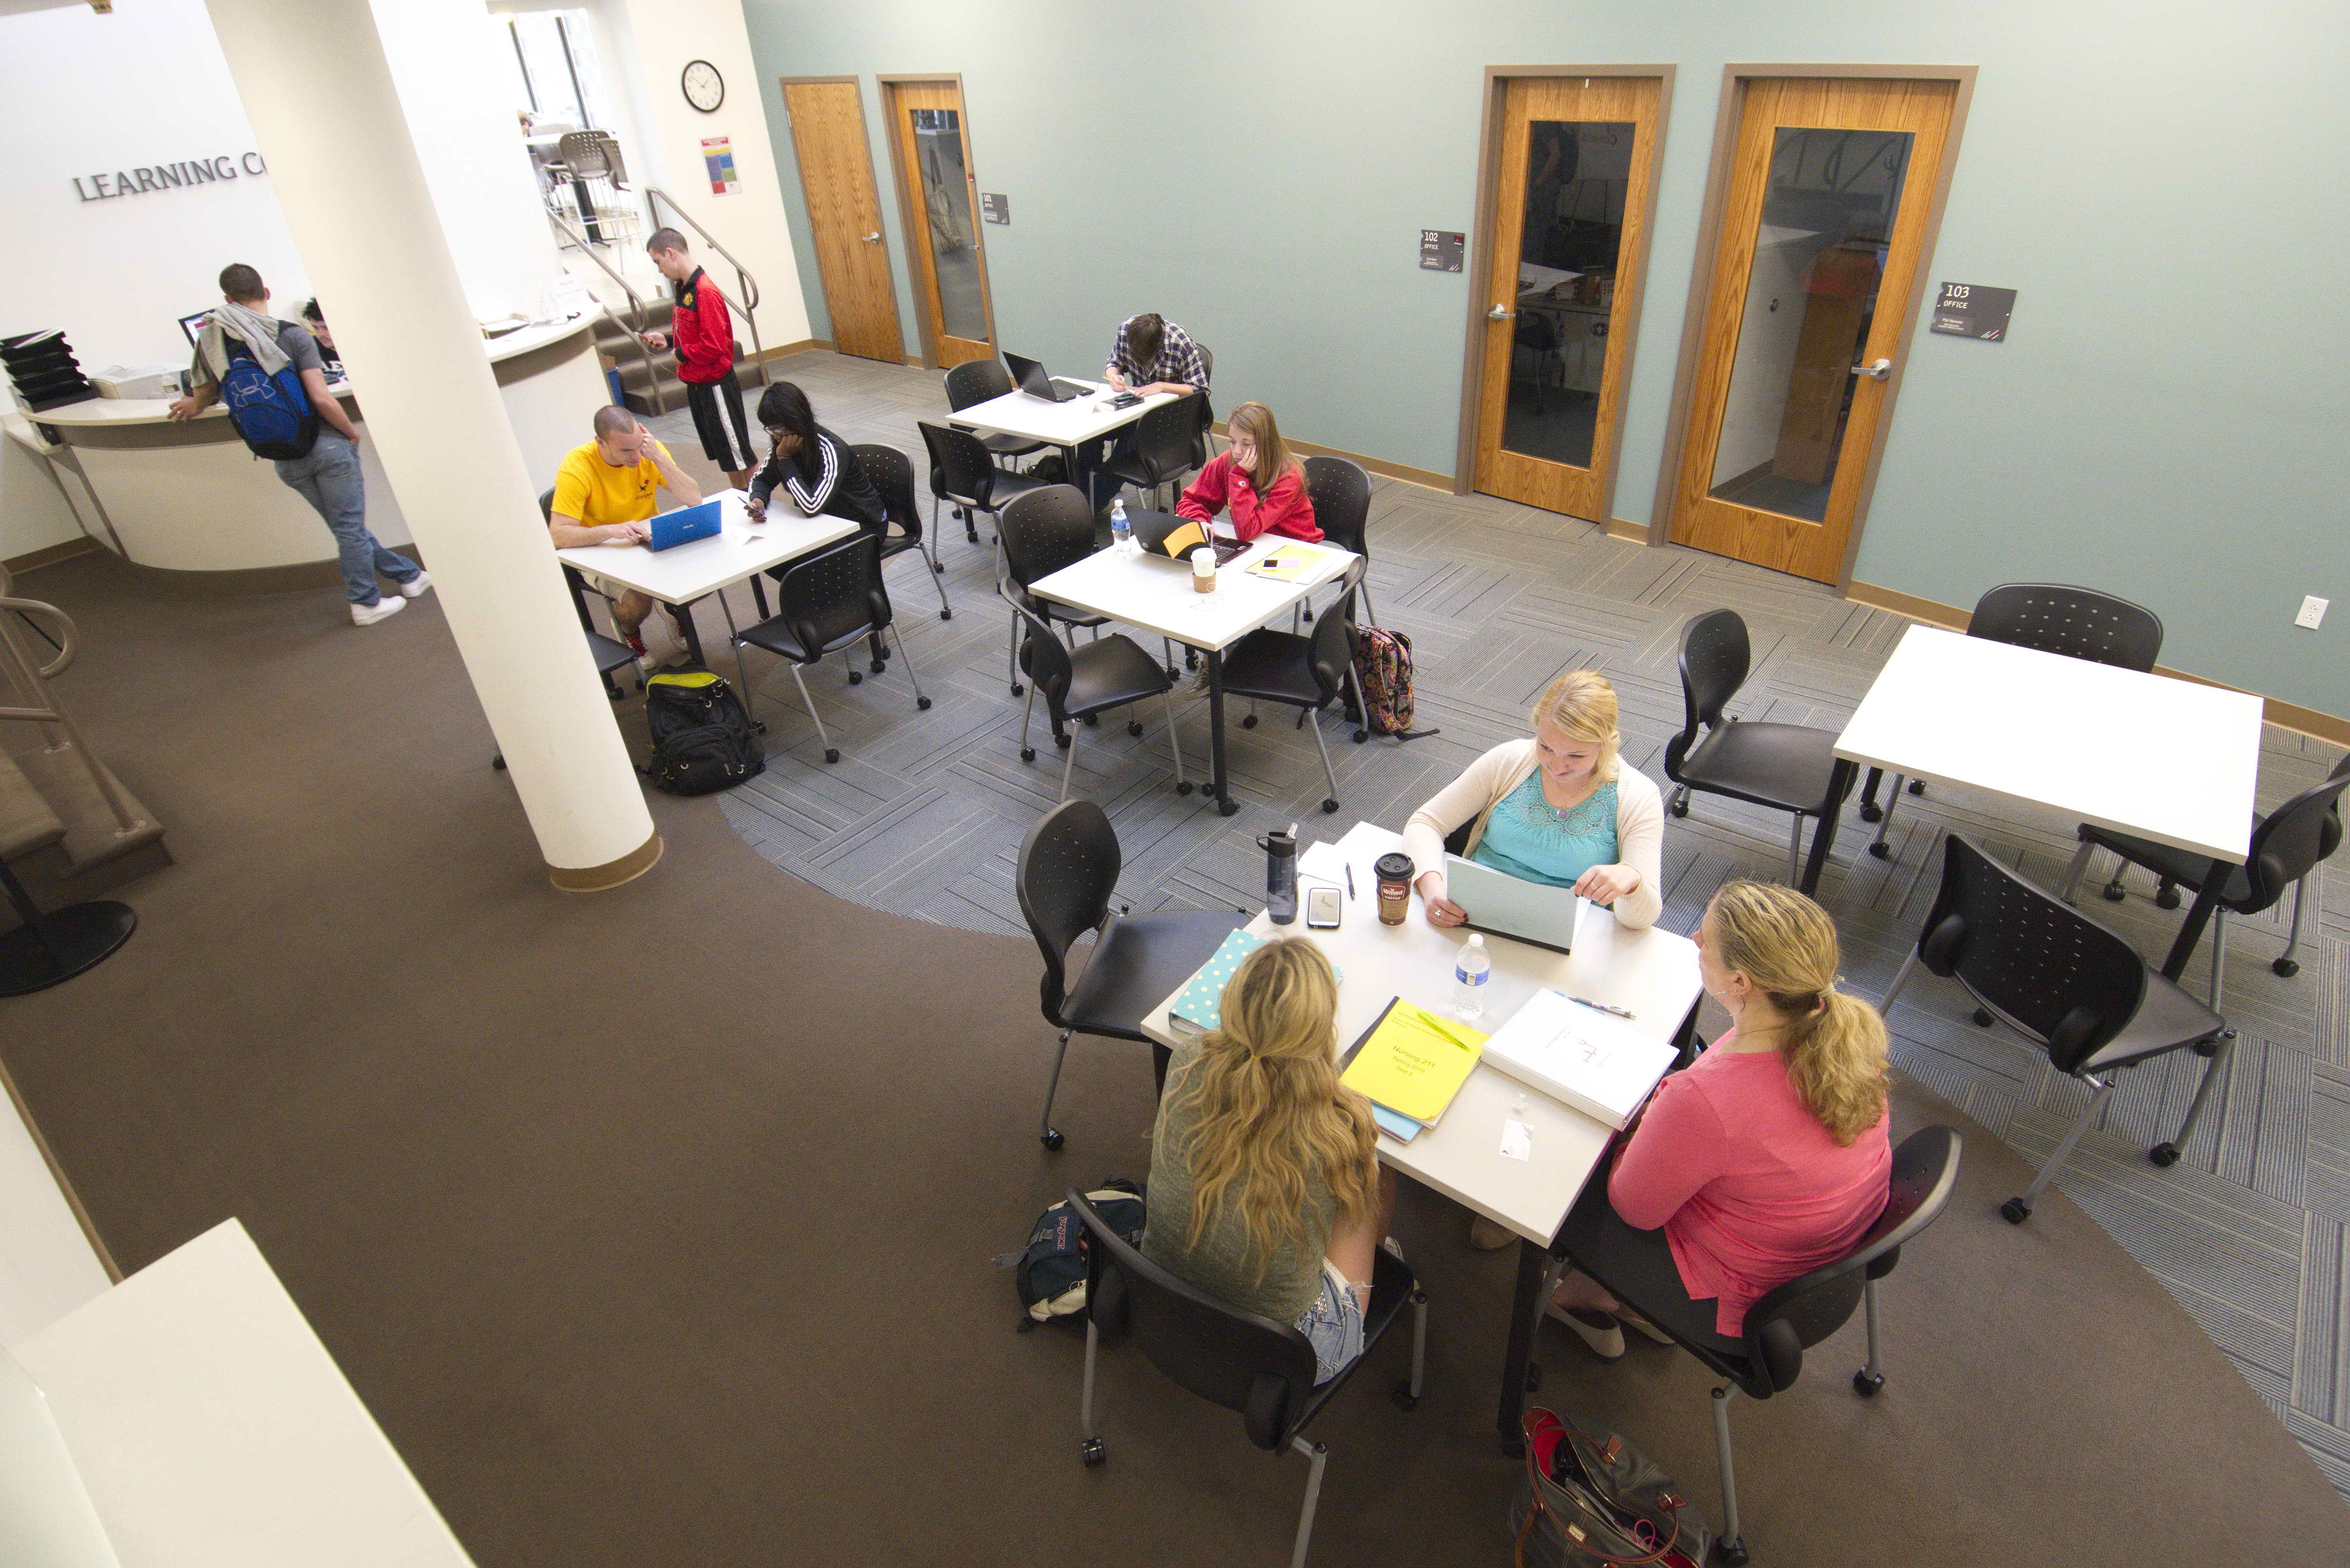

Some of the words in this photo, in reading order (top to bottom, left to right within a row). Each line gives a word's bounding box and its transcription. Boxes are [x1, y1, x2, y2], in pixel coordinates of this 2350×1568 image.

[72, 156, 238, 202] LEARNING
[242, 152, 267, 176] C
[1425, 232, 1438, 241] 102
[1946, 285, 1969, 298] 103
[1943, 300, 1968, 309] OFFICE
[1392, 1056, 1410, 1067] Spring
[1410, 1064, 1426, 1073] 2015
[1393, 1046, 1420, 1062] Nursing
[1421, 1059, 1435, 1068] 211
[1396, 1065, 1408, 1074] Test
[1057, 1216, 1067, 1250] JANSPORT
